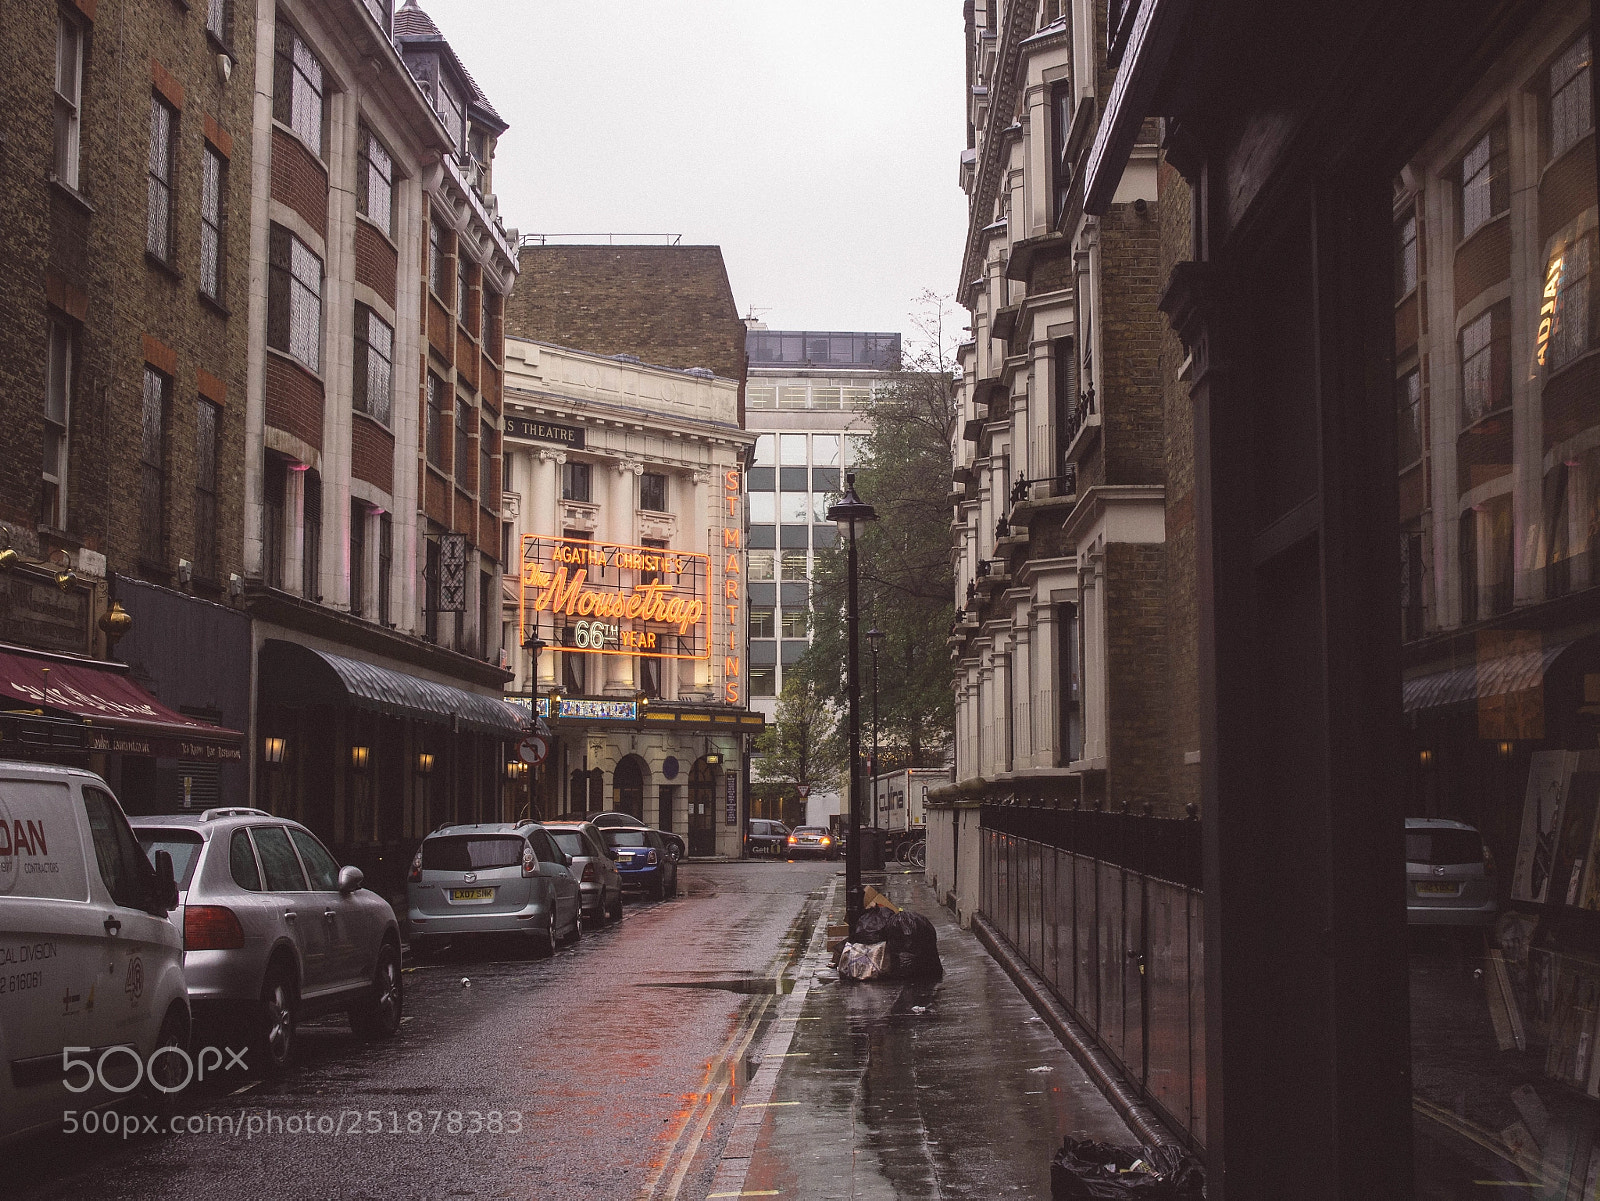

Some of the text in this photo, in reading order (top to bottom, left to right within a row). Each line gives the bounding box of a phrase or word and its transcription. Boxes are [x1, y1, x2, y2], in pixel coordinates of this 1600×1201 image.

[522, 422, 575, 442] THEATRE
[443, 541, 463, 604] IVY
[553, 546, 683, 575] AGATHA CHRISTIE'S
[523, 562, 702, 635] The Mousetrap
[724, 471, 739, 702] ST MARTINS
[575, 620, 657, 649] 66TH YEAR
[752, 846, 770, 854] Gett
[454, 890, 475, 899] LX07
[20, 942, 57, 963] DIVISION
